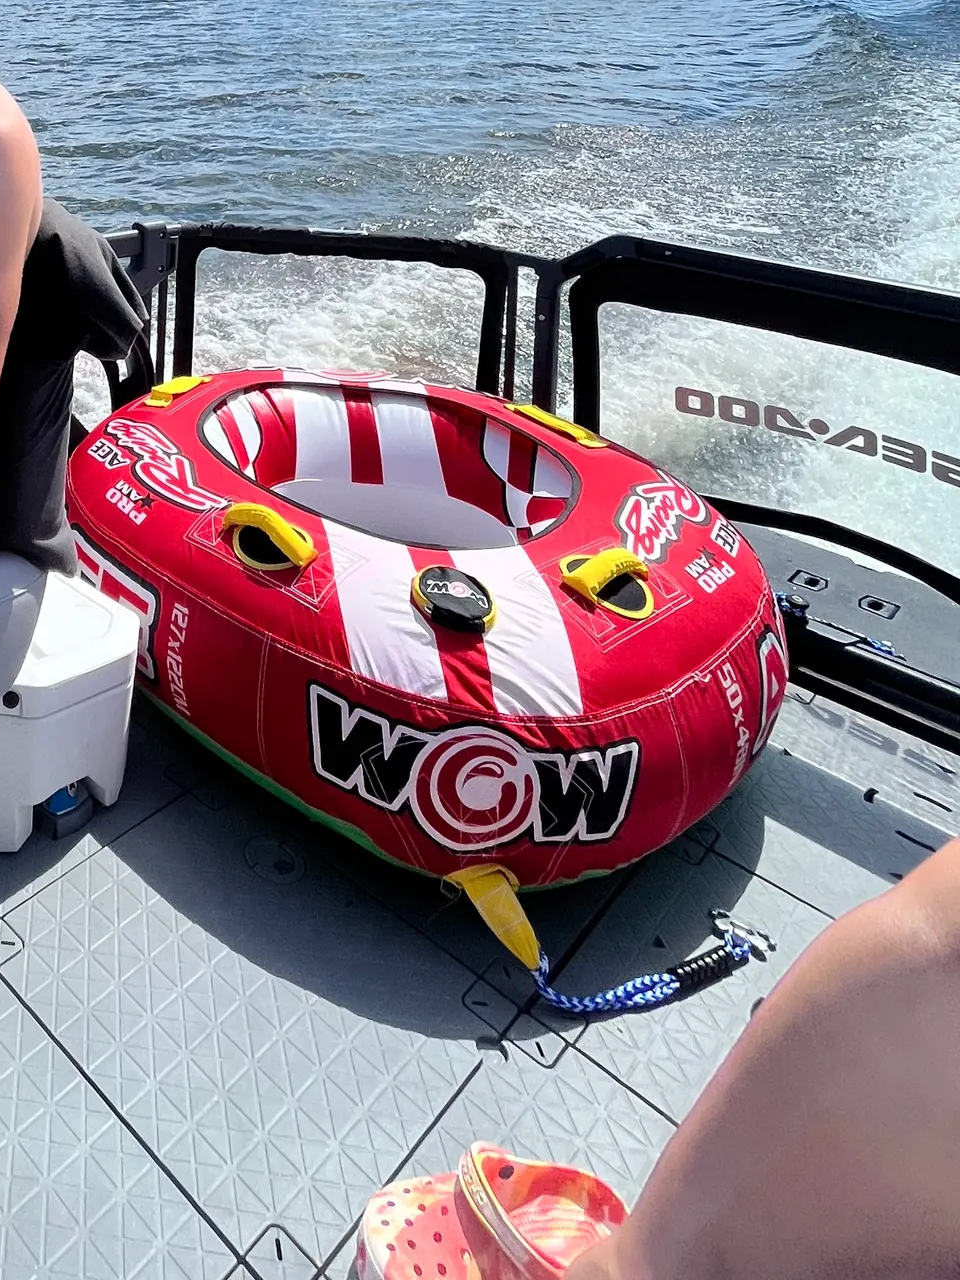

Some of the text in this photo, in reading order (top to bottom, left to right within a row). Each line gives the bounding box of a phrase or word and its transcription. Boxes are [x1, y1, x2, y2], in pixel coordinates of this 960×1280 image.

[105, 487, 147, 526] PRO
[115, 480, 144, 501] AM
[684, 554, 710, 578] AM
[697, 560, 737, 594] PRO
[310, 683, 640, 851] WOW
